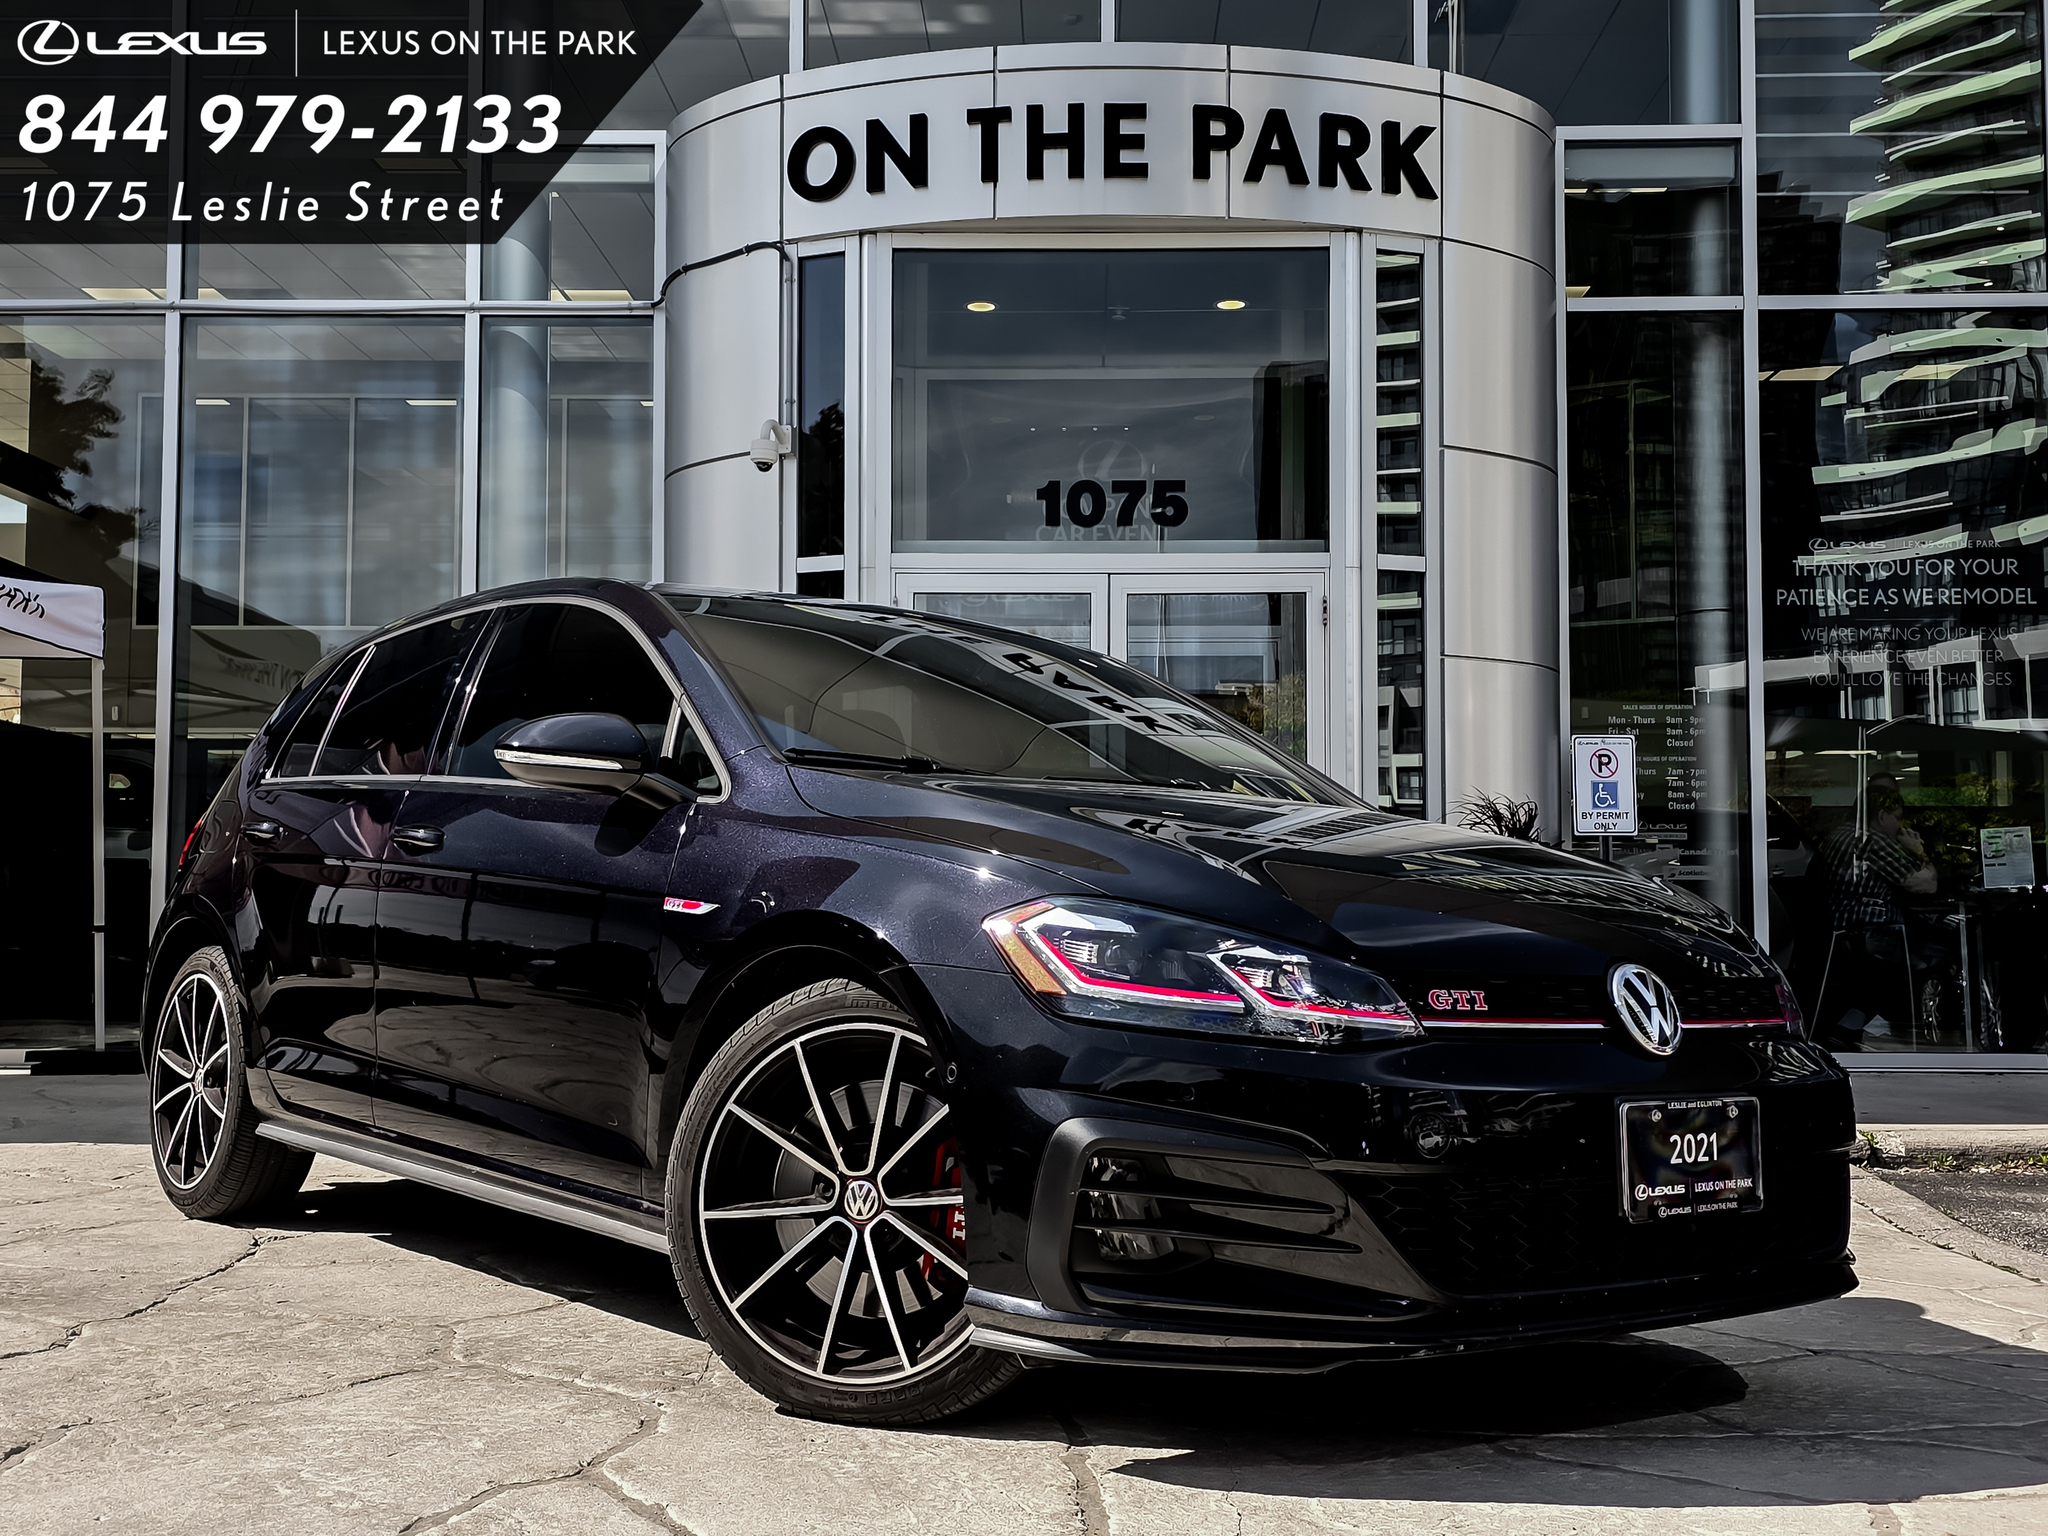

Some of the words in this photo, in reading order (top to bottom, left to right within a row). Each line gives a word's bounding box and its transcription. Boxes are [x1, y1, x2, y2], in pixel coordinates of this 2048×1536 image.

[786, 112, 929, 202] ON
[966, 101, 1149, 184] THE
[1192, 102, 1439, 201] PARK
[1036, 479, 1189, 528] 1075
[1830, 540, 1886, 549] LEXUS
[1903, 540, 1935, 549] LEXUS
[1975, 540, 2002, 548] PARK
[1793, 559, 1862, 577] THANK
[1866, 559, 1911, 577] YOU
[1915, 558, 1956, 576] FOR
[1960, 558, 2019, 576] YOUR
[1776, 588, 1869, 606] PATIENCE
[1873, 588, 1898, 605] AS
[1902, 588, 1934, 605] WE
[1938, 587, 2037, 605] REMODEL
[1801, 628, 1825, 641] WE
[1828, 628, 1855, 641] ARE
[1860, 628, 1920, 641] MAKING
[1924, 627, 1967, 641] YOUR
[1971, 627, 2018, 640] LEXUS
[1813, 650, 1904, 664] EXPERIENCE
[1909, 650, 1947, 664] EVEN
[1862, 672, 1901, 686] LOVE
[1907, 672, 1931, 686] THE
[1608, 716, 1626, 724] Mon
[1633, 716, 1656, 724] Thurs
[1666, 716, 1683, 724] 9am
[1689, 716, 1706, 725] 9pm
[1608, 727, 1619, 735] Fri
[1625, 727, 1640, 735] Sat
[1666, 727, 1683, 735] 9am
[1666, 738, 1694, 747] Closed
[1667, 768, 1684, 776] 7am
[1667, 779, 1684, 787] 7am
[1691, 779, 1708, 788] 6pm
[1691, 790, 1708, 800] 4pm
[1668, 801, 1695, 810] Closed
[1581, 812, 1594, 820] BY
[1596, 812, 1630, 820] PERMIT
[1593, 822, 1618, 831] ONLY
[1428, 989, 1488, 1011] GTI
[1669, 1132, 1718, 1165] 2021
[1649, 1184, 1686, 1196] LEXUS
[1694, 1181, 1714, 1192] LEXUS
[1714, 1181, 1724, 1191] ON
[1725, 1179, 1737, 1189] THE
[1737, 1178, 1753, 1188] PARK
[1667, 1206, 1692, 1215] LEXUS
